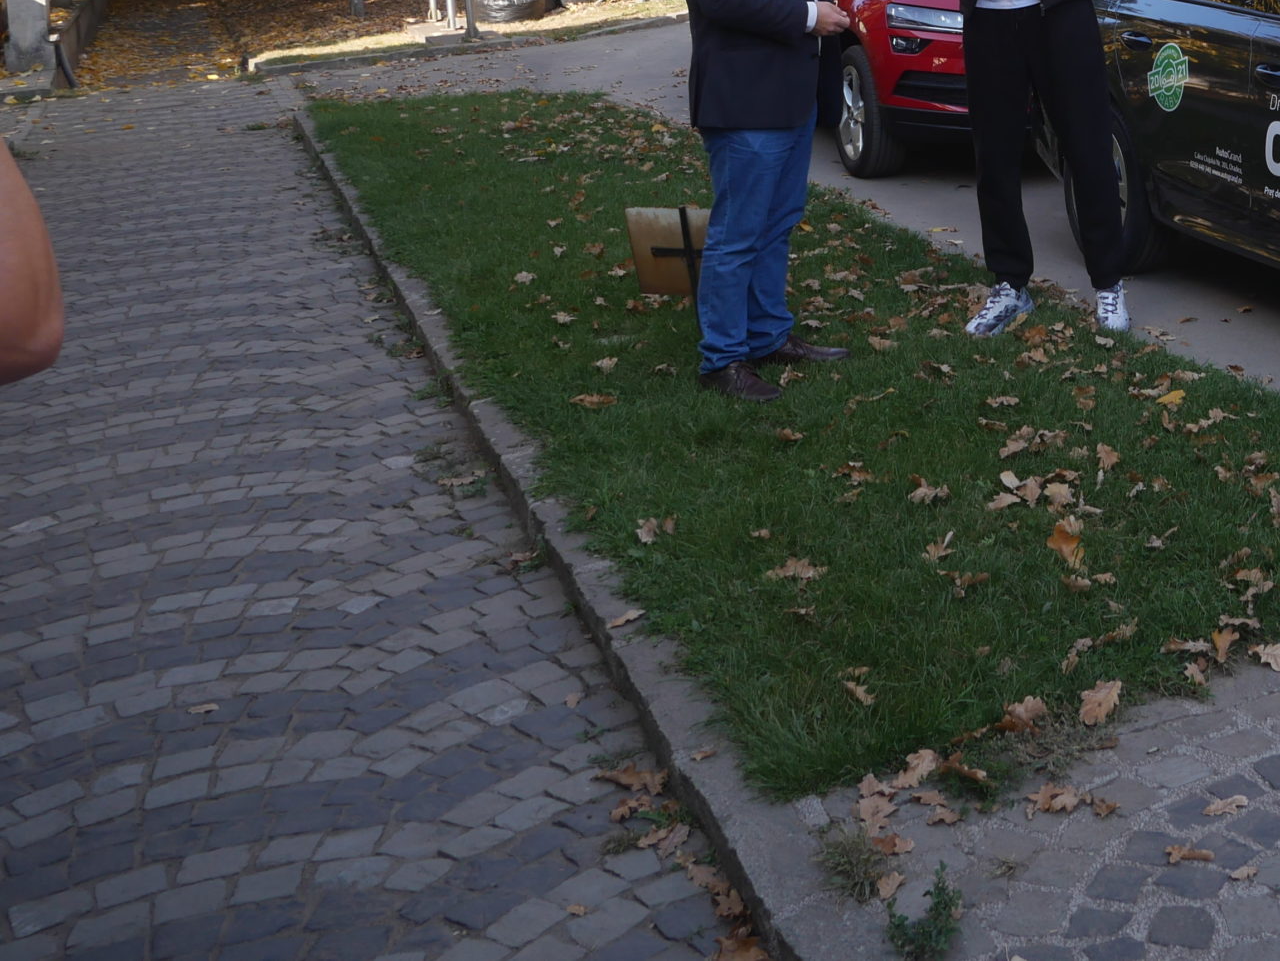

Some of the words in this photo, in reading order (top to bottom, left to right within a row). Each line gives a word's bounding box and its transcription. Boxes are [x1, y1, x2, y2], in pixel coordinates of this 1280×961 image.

[1151, 75, 1160, 89] 20
[1177, 63, 1186, 78] 21
[1159, 86, 1182, 108] RABLA
[1215, 146, 1242, 163] AutoGrand
[1275, 190, 1280, 199] de
